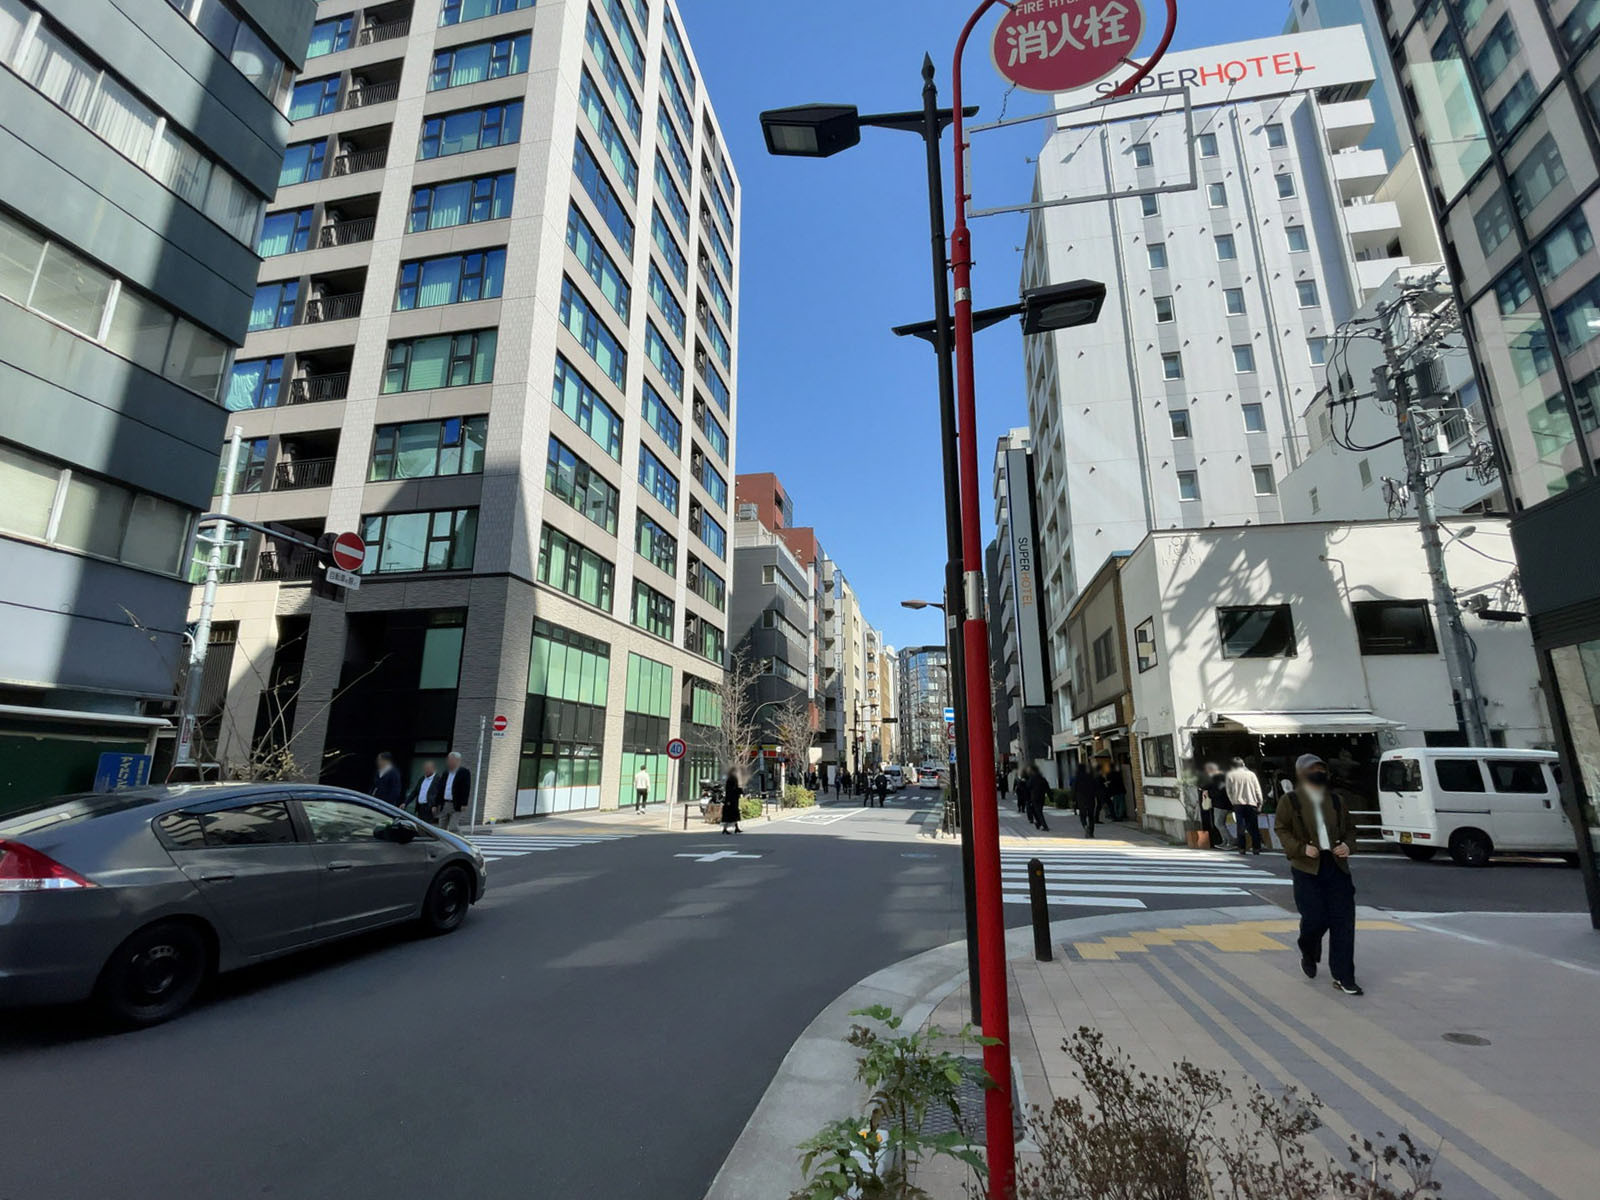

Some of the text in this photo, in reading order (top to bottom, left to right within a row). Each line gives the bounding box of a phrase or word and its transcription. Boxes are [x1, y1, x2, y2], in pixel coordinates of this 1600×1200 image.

[1015, 1, 1044, 17] FIRE
[1006, 1, 1130, 67] 消火栓
[670, 743, 683, 754] 40
